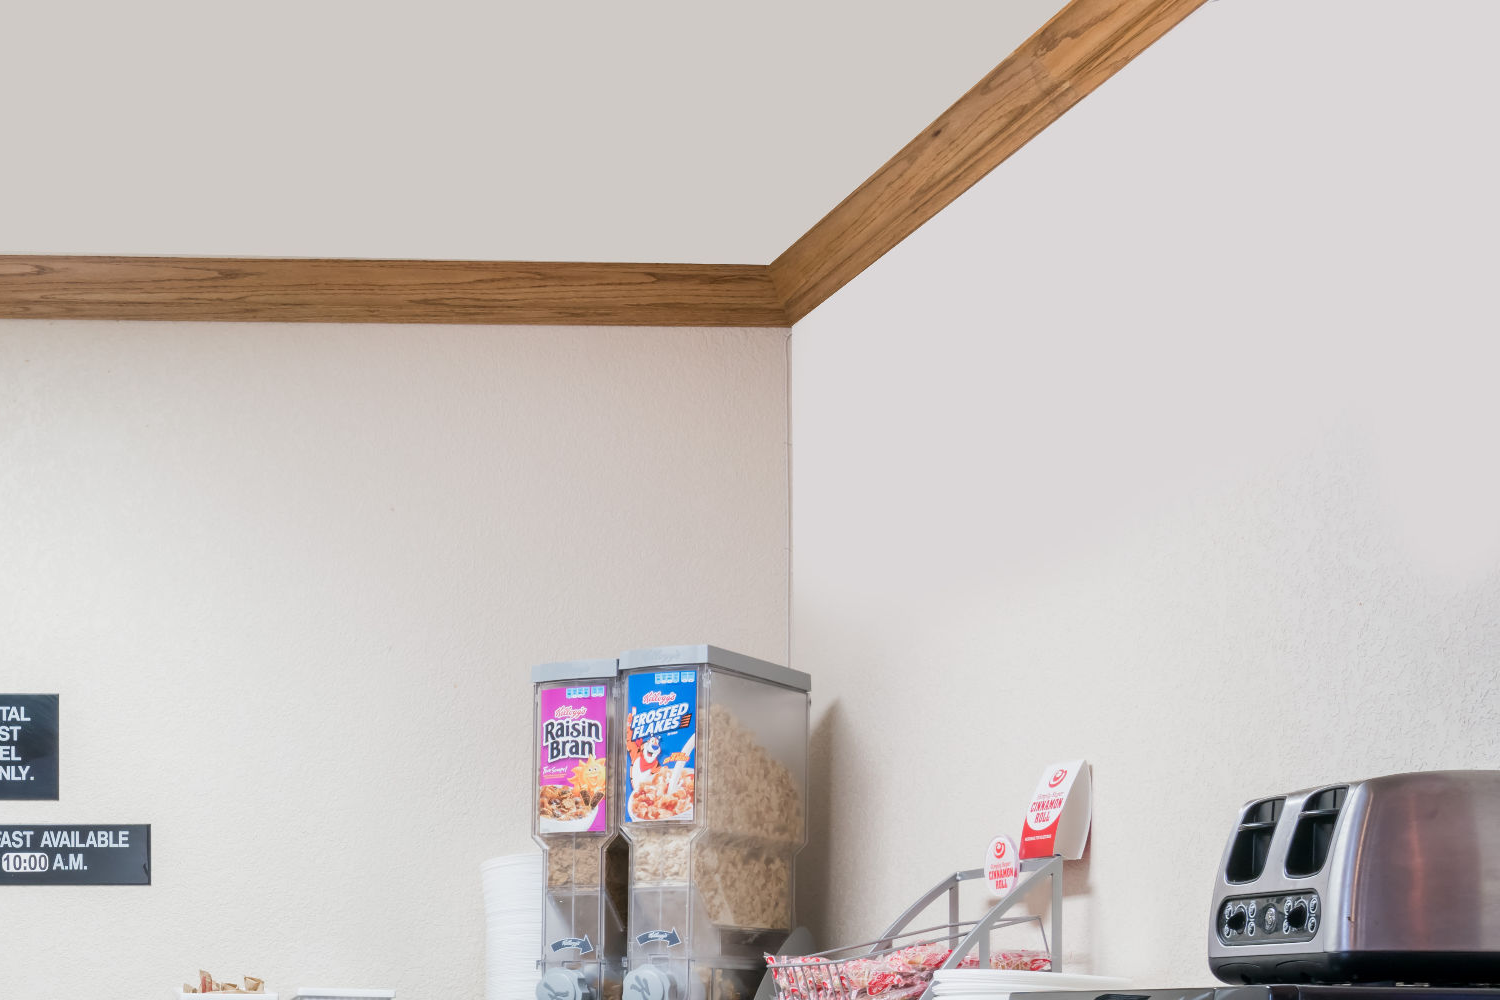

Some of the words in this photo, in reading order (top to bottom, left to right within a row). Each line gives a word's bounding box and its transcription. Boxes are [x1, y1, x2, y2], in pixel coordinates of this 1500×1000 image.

[632, 702, 689, 729] FROSTED
[543, 719, 602, 745] Raisin
[632, 716, 681, 741] FLAKES
[548, 739, 594, 761] Bran
[1030, 797, 1064, 813] CINNAMON
[1034, 811, 1051, 824] ROLL
[40, 831, 130, 848] AVAILABLE
[3, 853, 48, 872] 10:00
[52, 853, 88, 871] A.M.
[988, 867, 1014, 881] CINNAMON
[995, 879, 1008, 890] ROLL
